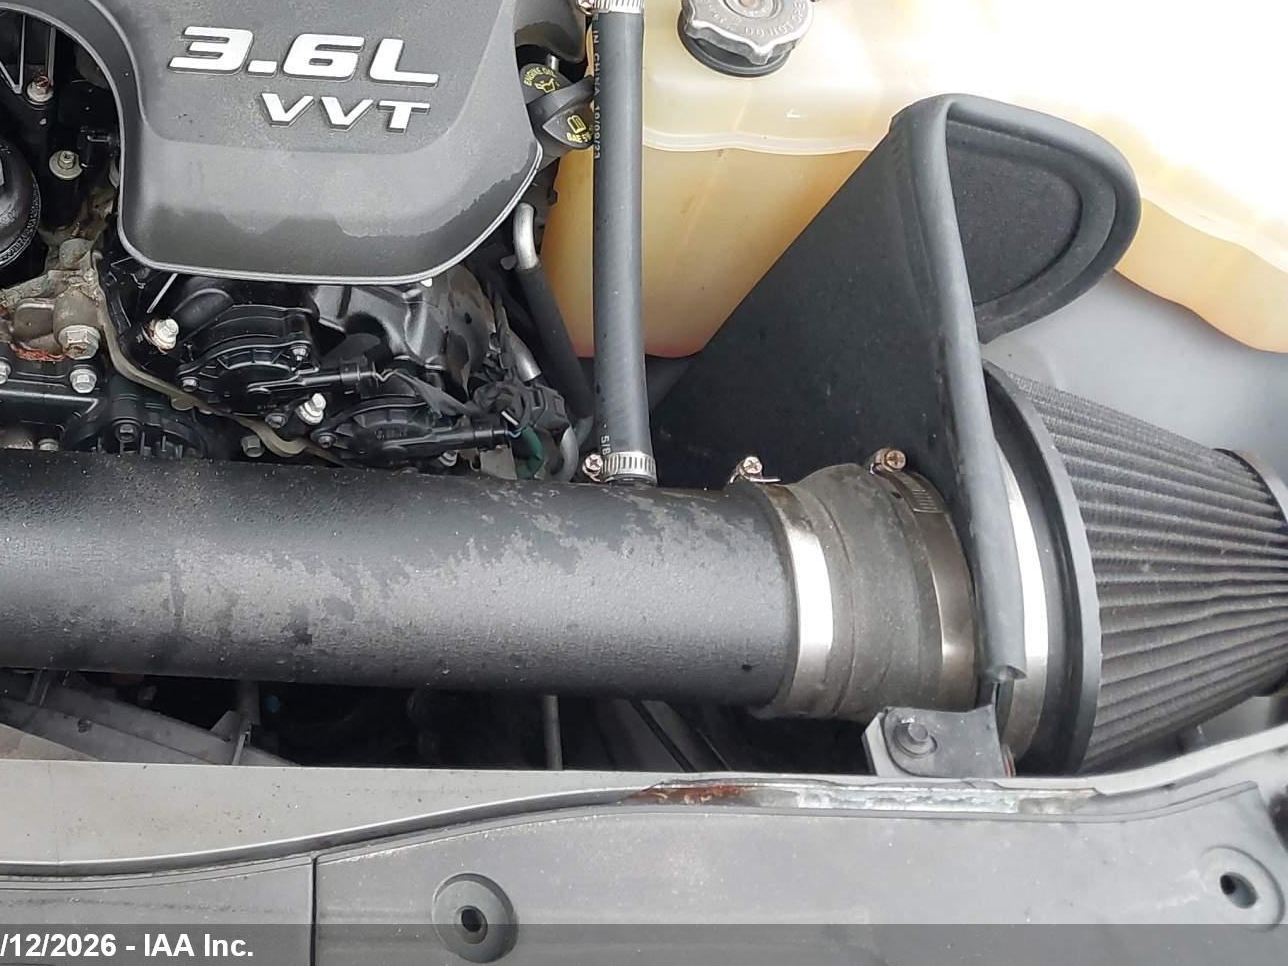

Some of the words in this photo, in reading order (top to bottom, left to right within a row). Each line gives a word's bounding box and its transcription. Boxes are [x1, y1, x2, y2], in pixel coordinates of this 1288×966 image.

[167, 25, 440, 88] 3.6L
[523, 66, 543, 87] ENGINE
[261, 92, 431, 133] VVT
